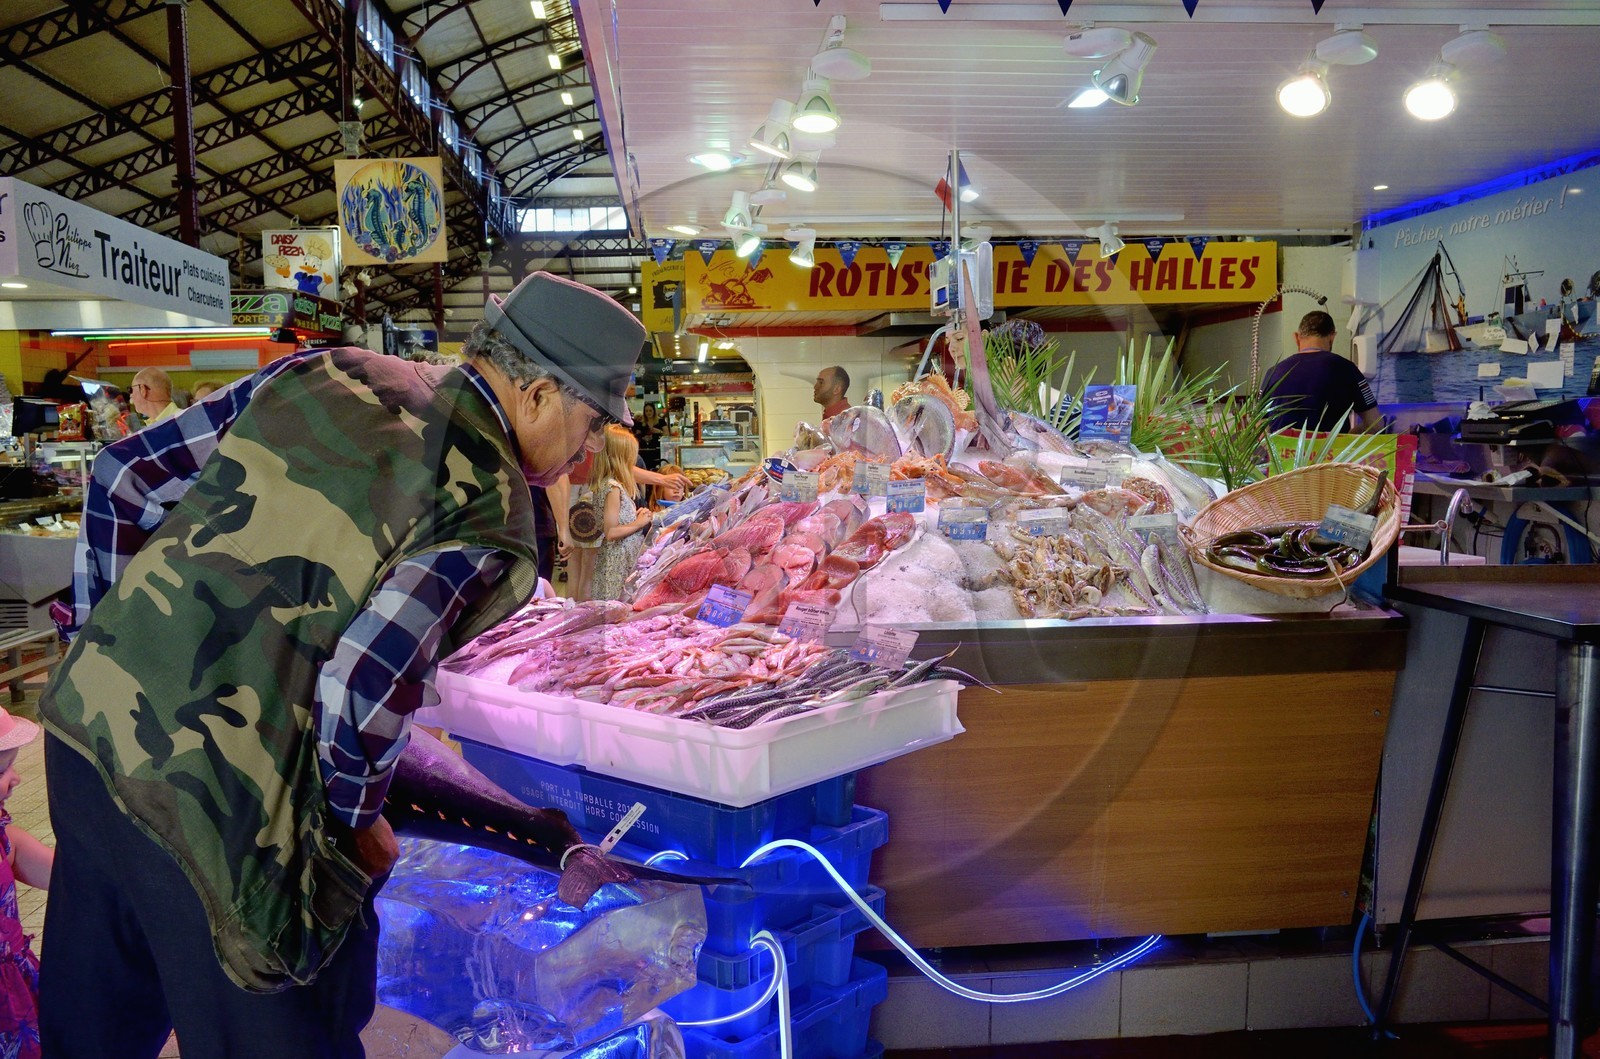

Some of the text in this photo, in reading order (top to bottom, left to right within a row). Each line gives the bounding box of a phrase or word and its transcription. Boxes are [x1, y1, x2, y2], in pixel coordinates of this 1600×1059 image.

[55, 212, 92, 252] Philippe
[1394, 185, 1568, 249] Pêcher, notre métier !
[271, 234, 298, 245] DAISY
[278, 245, 305, 256] PIZZA
[94, 229, 181, 298] Traiteur
[182, 259, 225, 287] Plats cuisinés
[809, 255, 1260, 298] ROTISIE DES HALLES
[187, 286, 224, 309] Charcuterie
[232, 314, 270, 323] PORTER
[521, 786, 544, 800] USAGE
[547, 793, 581, 811] INTERDIT
[585, 806, 606, 818] HORS
[540, 780, 558, 794] PORT
[561, 786, 571, 797] LA
[575, 791, 613, 810] TURBALLE
